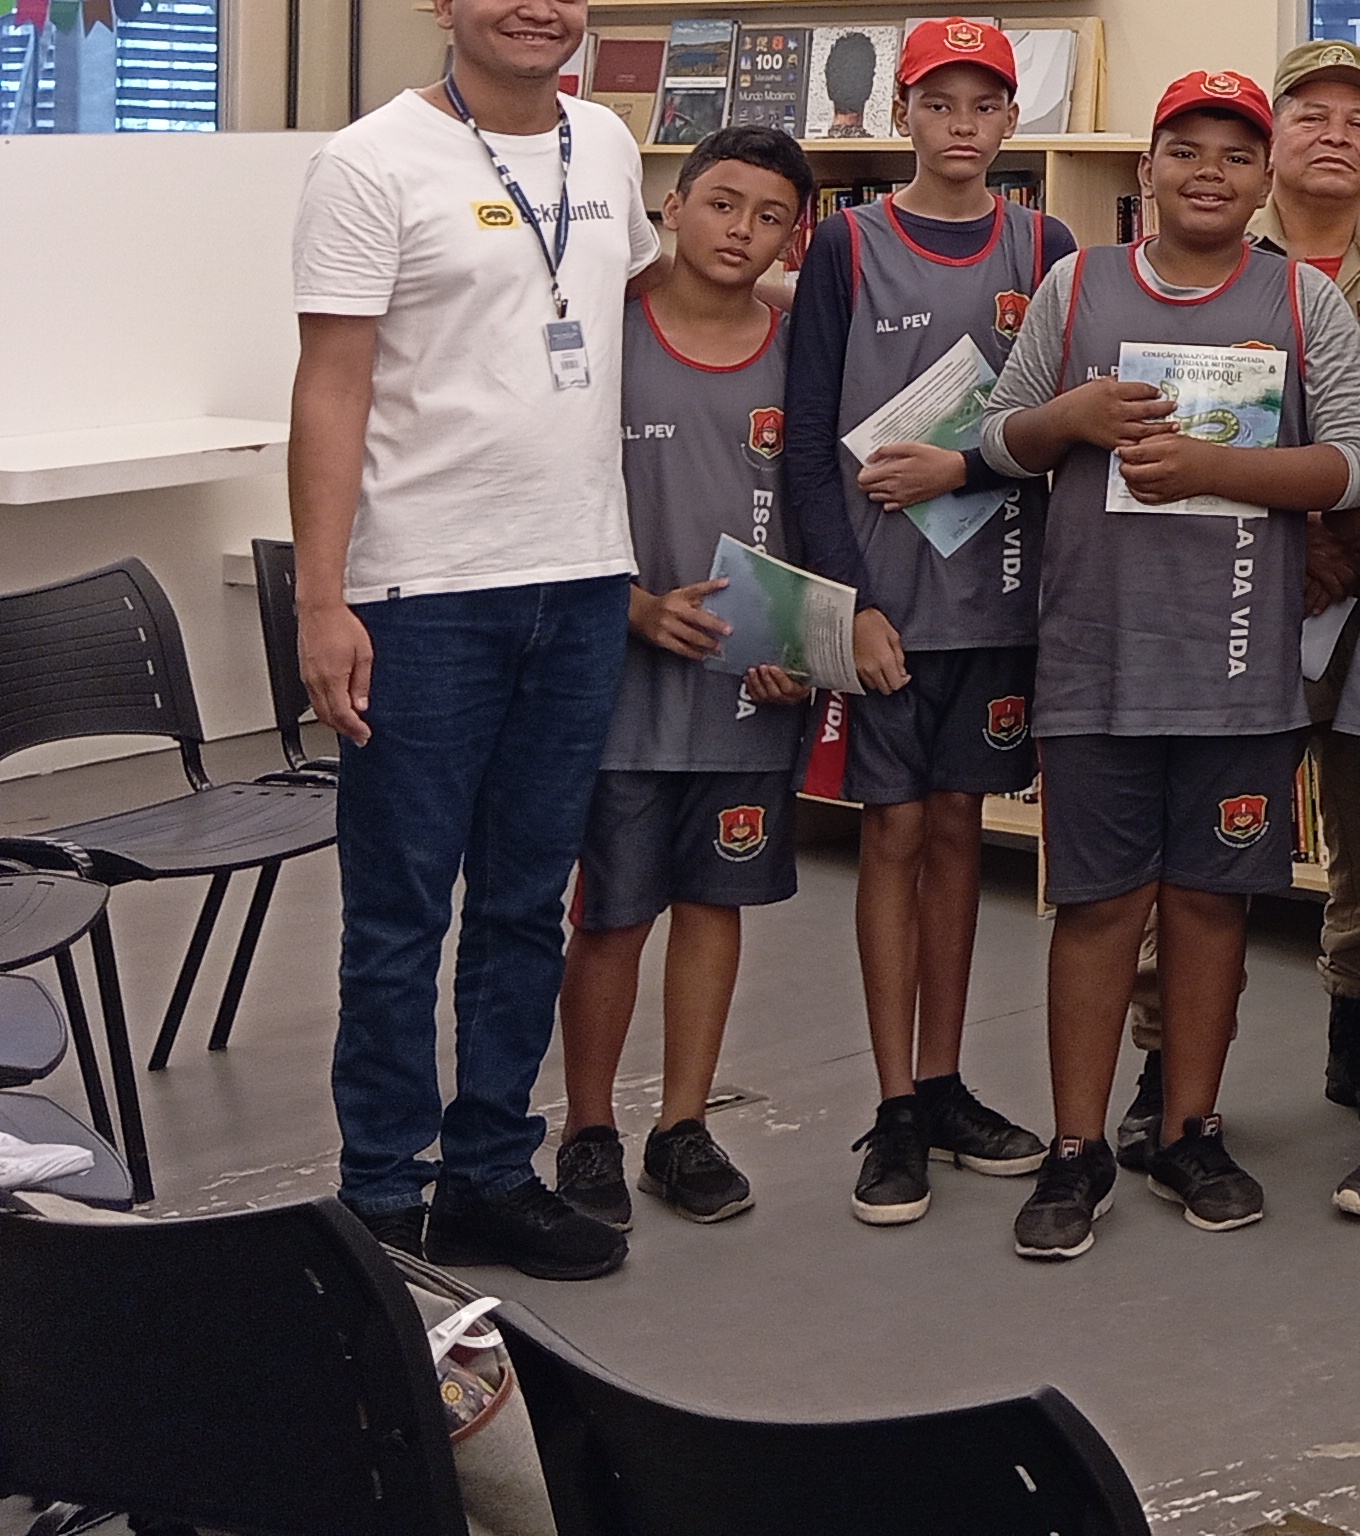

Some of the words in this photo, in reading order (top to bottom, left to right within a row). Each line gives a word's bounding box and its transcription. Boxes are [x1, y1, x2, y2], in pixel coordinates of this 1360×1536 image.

[755, 53, 783, 70] 100
[739, 91, 763, 101] Mundo
[764, 90, 797, 101] Moderno
[876, 319, 899, 334] AL.
[903, 313, 932, 329] PEV
[1164, 367, 1185, 379] RIO
[645, 425, 676, 439] PEV
[1002, 528, 1024, 594] VIDA
[1232, 559, 1254, 598] DA
[1228, 606, 1251, 679] VIDA
